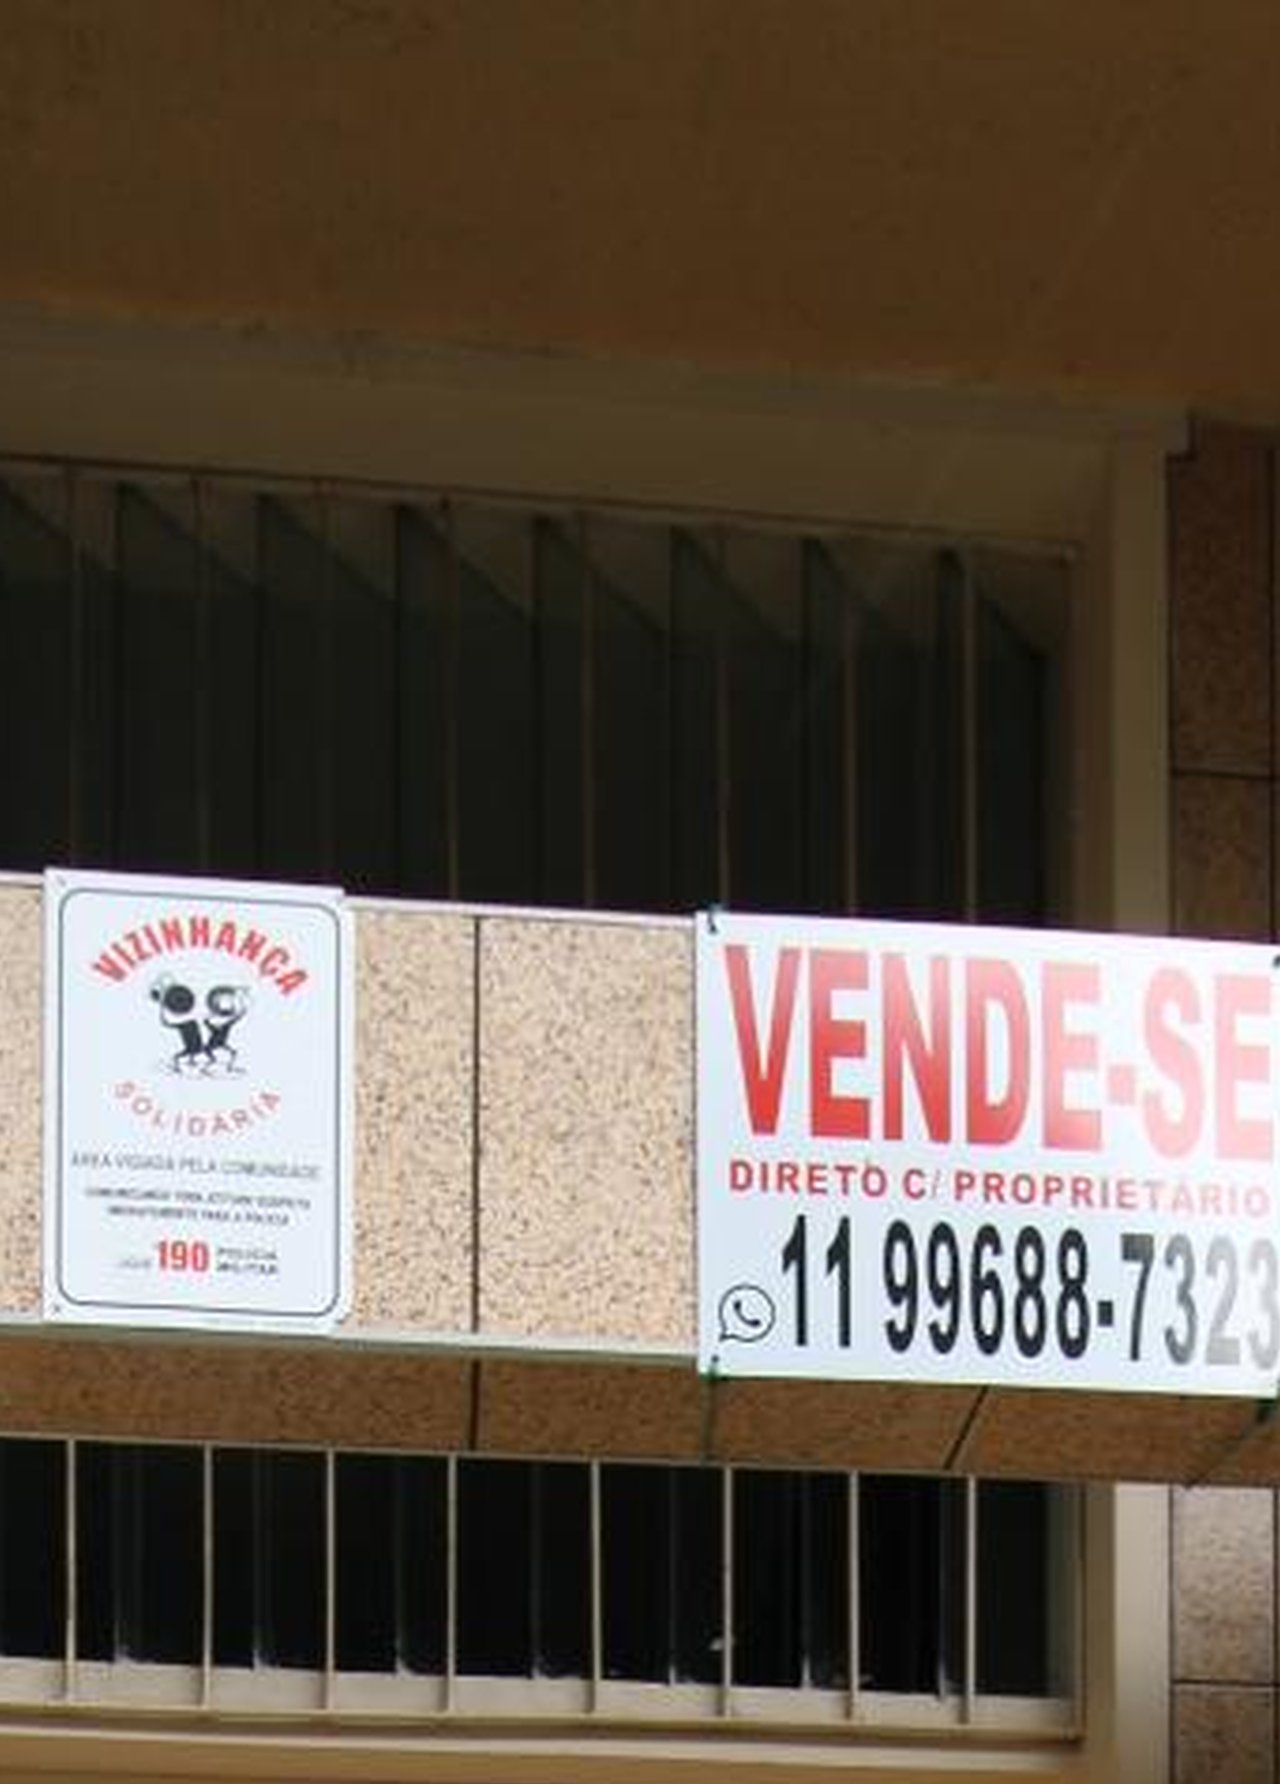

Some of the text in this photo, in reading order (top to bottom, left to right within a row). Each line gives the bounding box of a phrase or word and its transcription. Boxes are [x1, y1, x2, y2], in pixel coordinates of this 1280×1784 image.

[724, 944, 1276, 1162] VENDE-SE
[729, 1159, 887, 1197] DIRETO
[903, 1167, 939, 1201] C/
[154, 1239, 210, 1273] 190
[782, 1214, 852, 1348] 11
